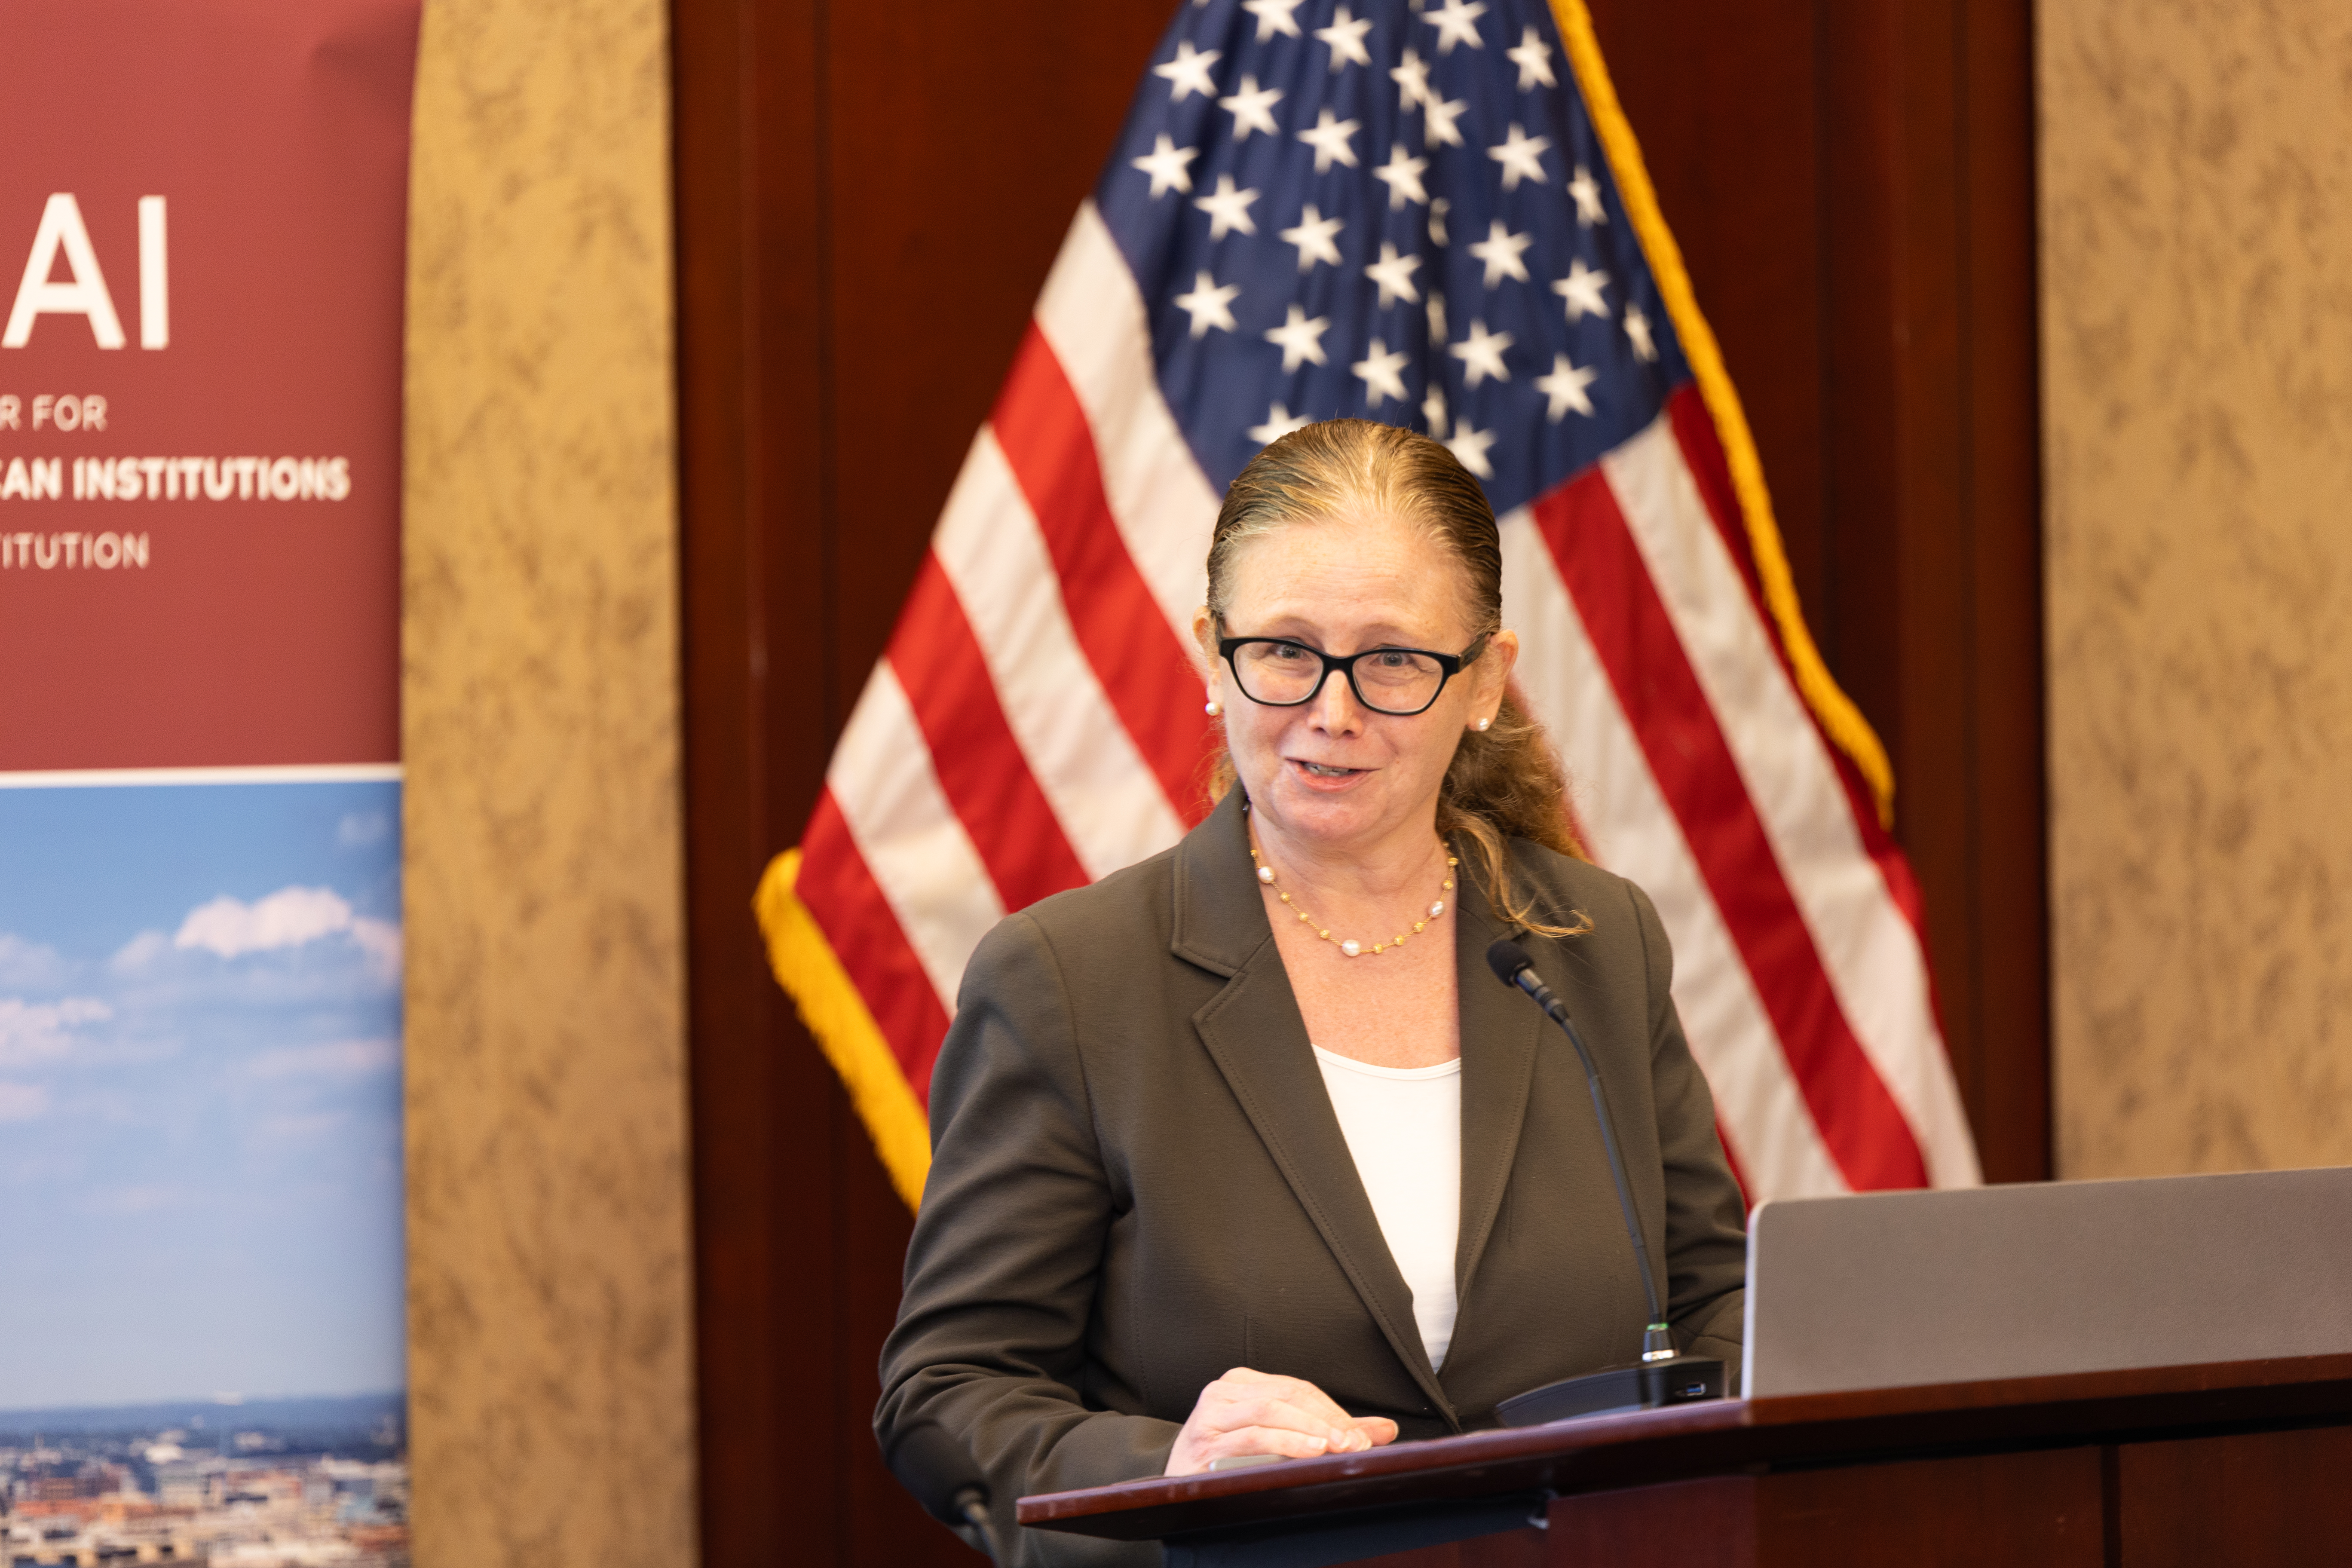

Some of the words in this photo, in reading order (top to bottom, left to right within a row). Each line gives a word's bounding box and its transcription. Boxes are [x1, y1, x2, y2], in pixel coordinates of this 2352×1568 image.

[2, 192, 169, 350] AI
[0, 395, 21, 431] R
[32, 395, 107, 432] FOR
[0, 456, 63, 500] AN
[73, 456, 351, 501] INSTITUTIONS
[0, 532, 150, 570] ITUTION
